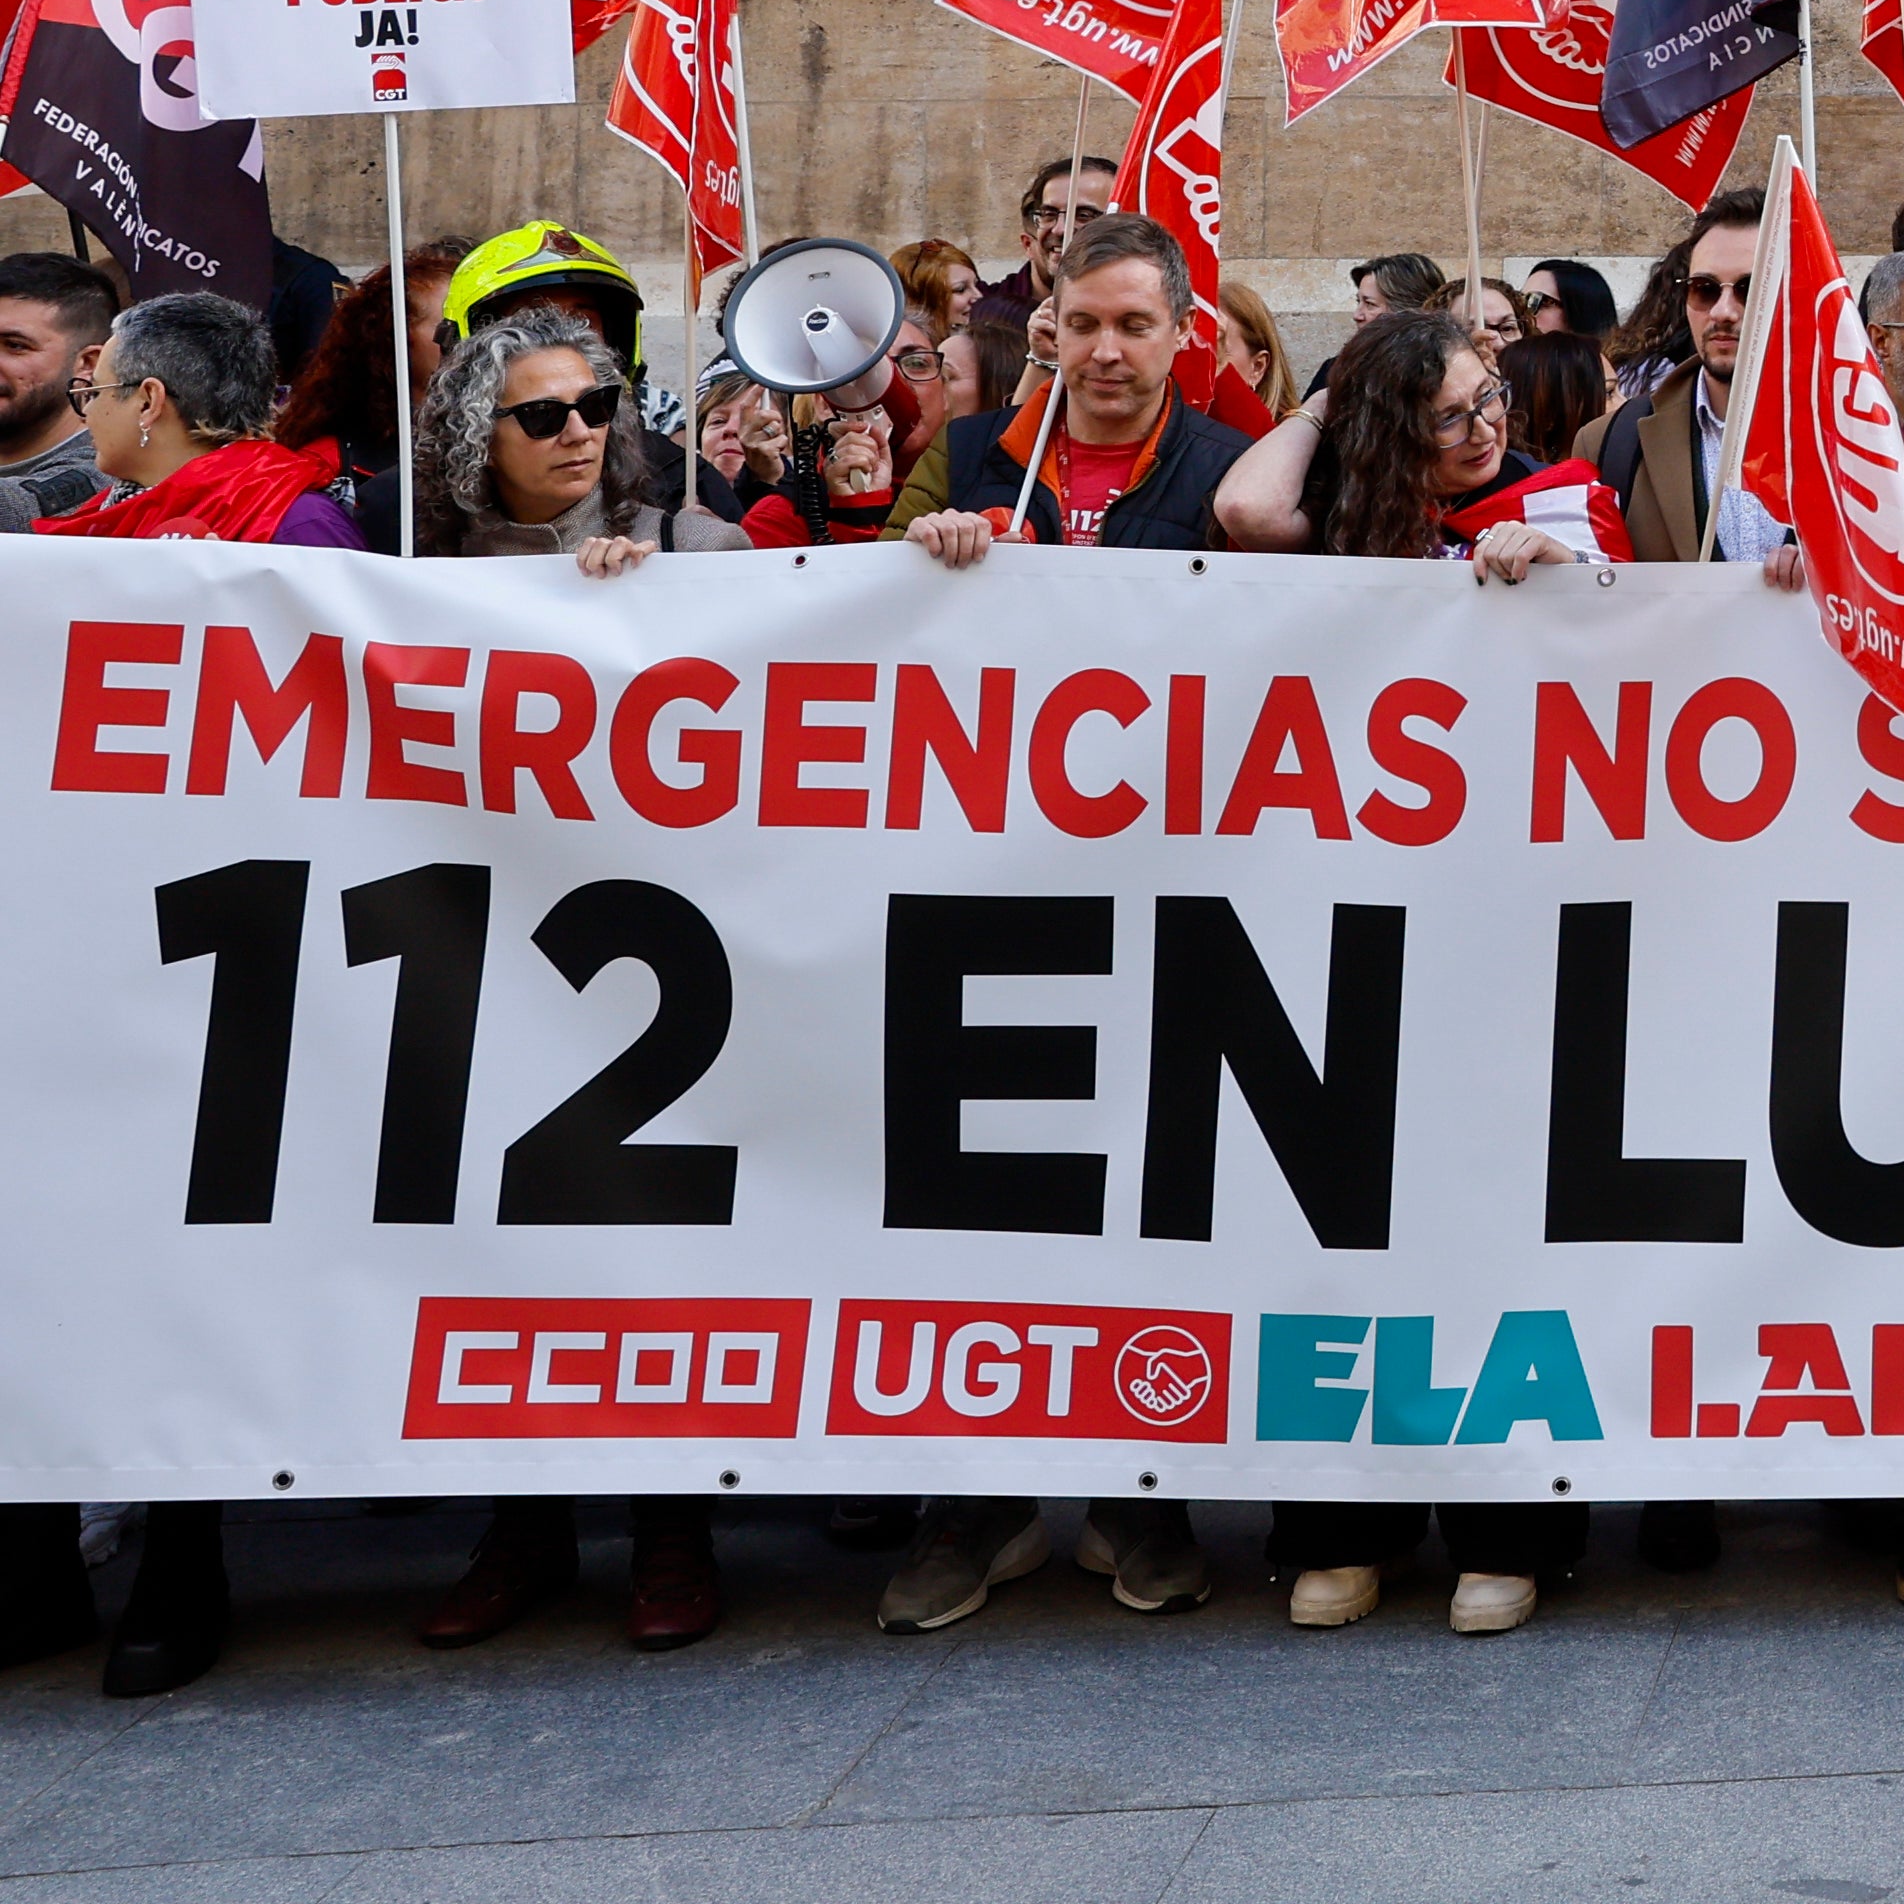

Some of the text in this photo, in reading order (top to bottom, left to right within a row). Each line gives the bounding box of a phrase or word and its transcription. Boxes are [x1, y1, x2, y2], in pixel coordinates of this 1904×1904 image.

[354, 9, 420, 49] JA!
[374, 88, 406, 101] CGT
[32, 97, 139, 199] FEDERACIÓN
[50, 619, 1469, 846] EMERGENCIAS
[1529, 676, 1798, 844] NO
[153, 859, 740, 1227] 112
[881, 892, 1408, 1252] EN
[436, 1329, 783, 1407] CCOO
[850, 1319, 1102, 1418] UGT
[1255, 1308, 1606, 1446] ELA
